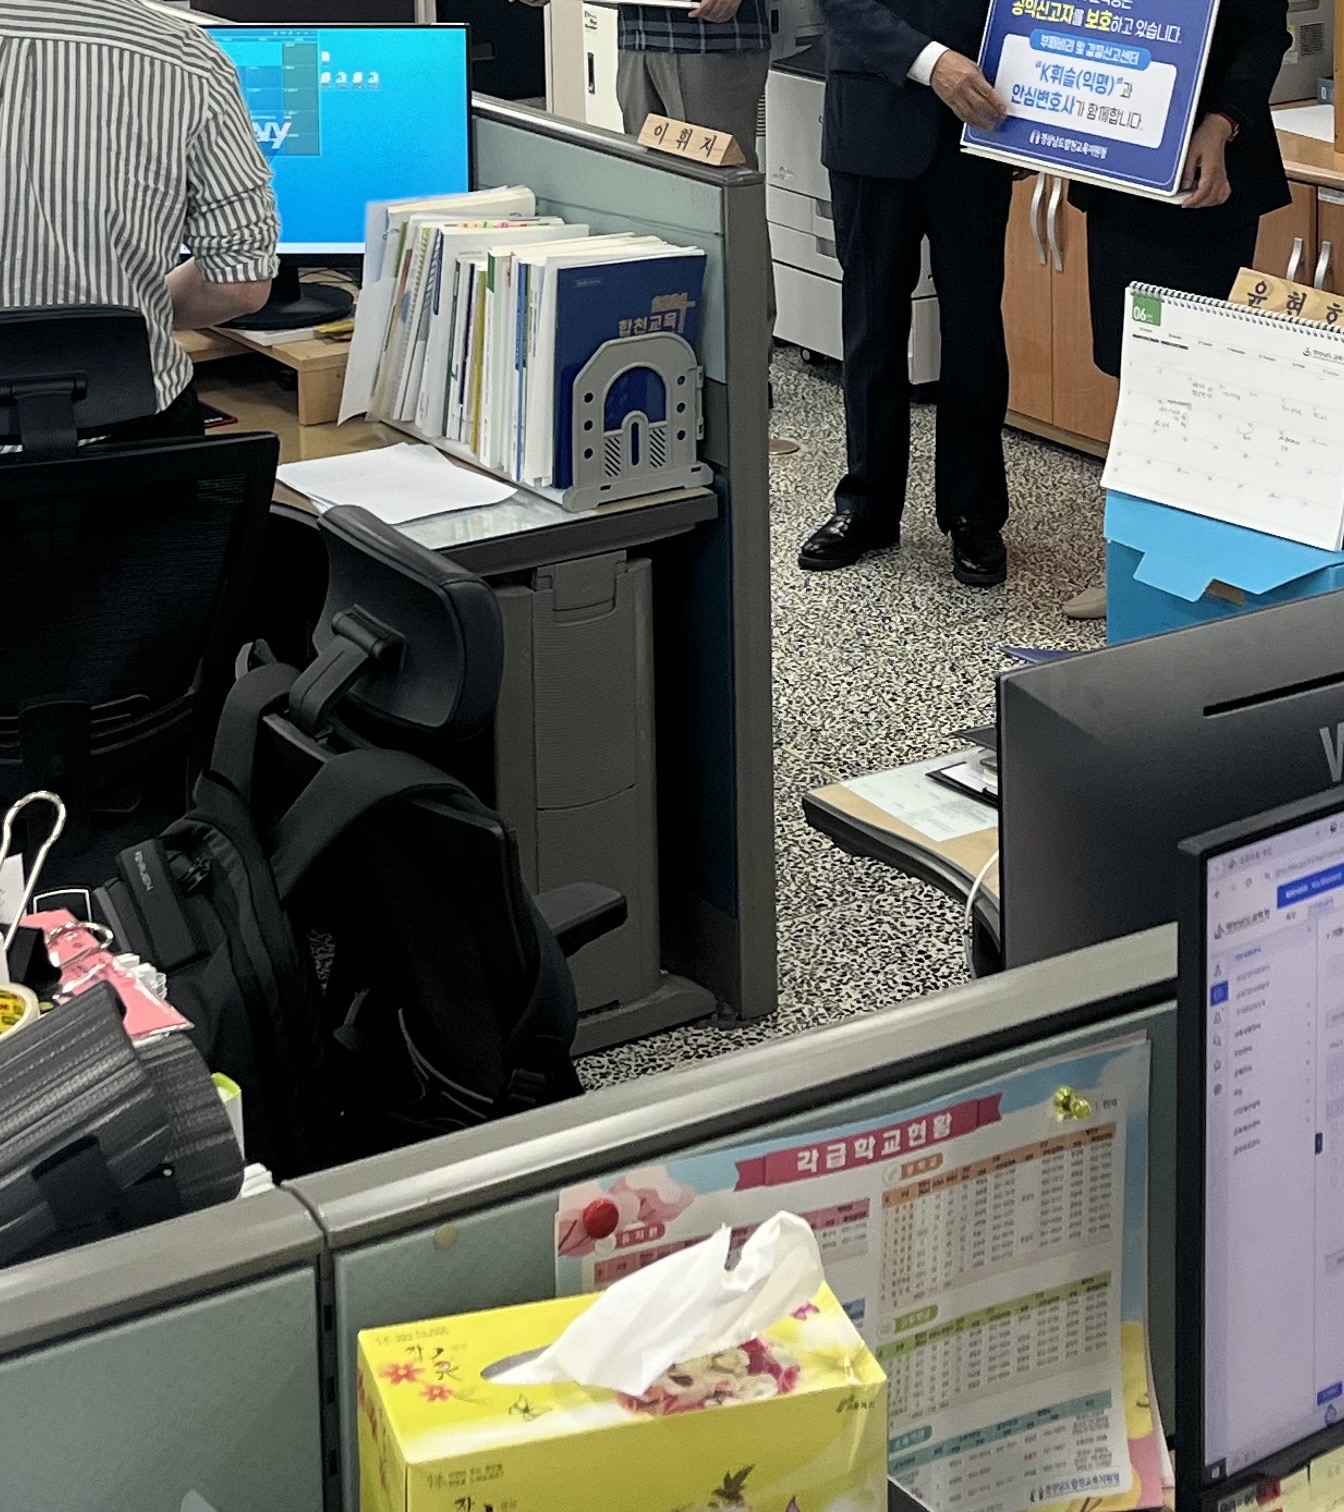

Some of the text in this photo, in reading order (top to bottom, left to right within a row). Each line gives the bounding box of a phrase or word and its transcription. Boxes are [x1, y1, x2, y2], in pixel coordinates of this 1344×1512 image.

[1085, 8, 1134, 35] 보호하고
[1134, 19, 1182, 45] 있습니다.
[1011, 84, 1143, 131] 안심변호사가 함께합니다.
[654, 122, 718, 158] 이휘지
[1133, 306, 1146, 321] 06
[797, 1112, 953, 1174] 각급학교현황
